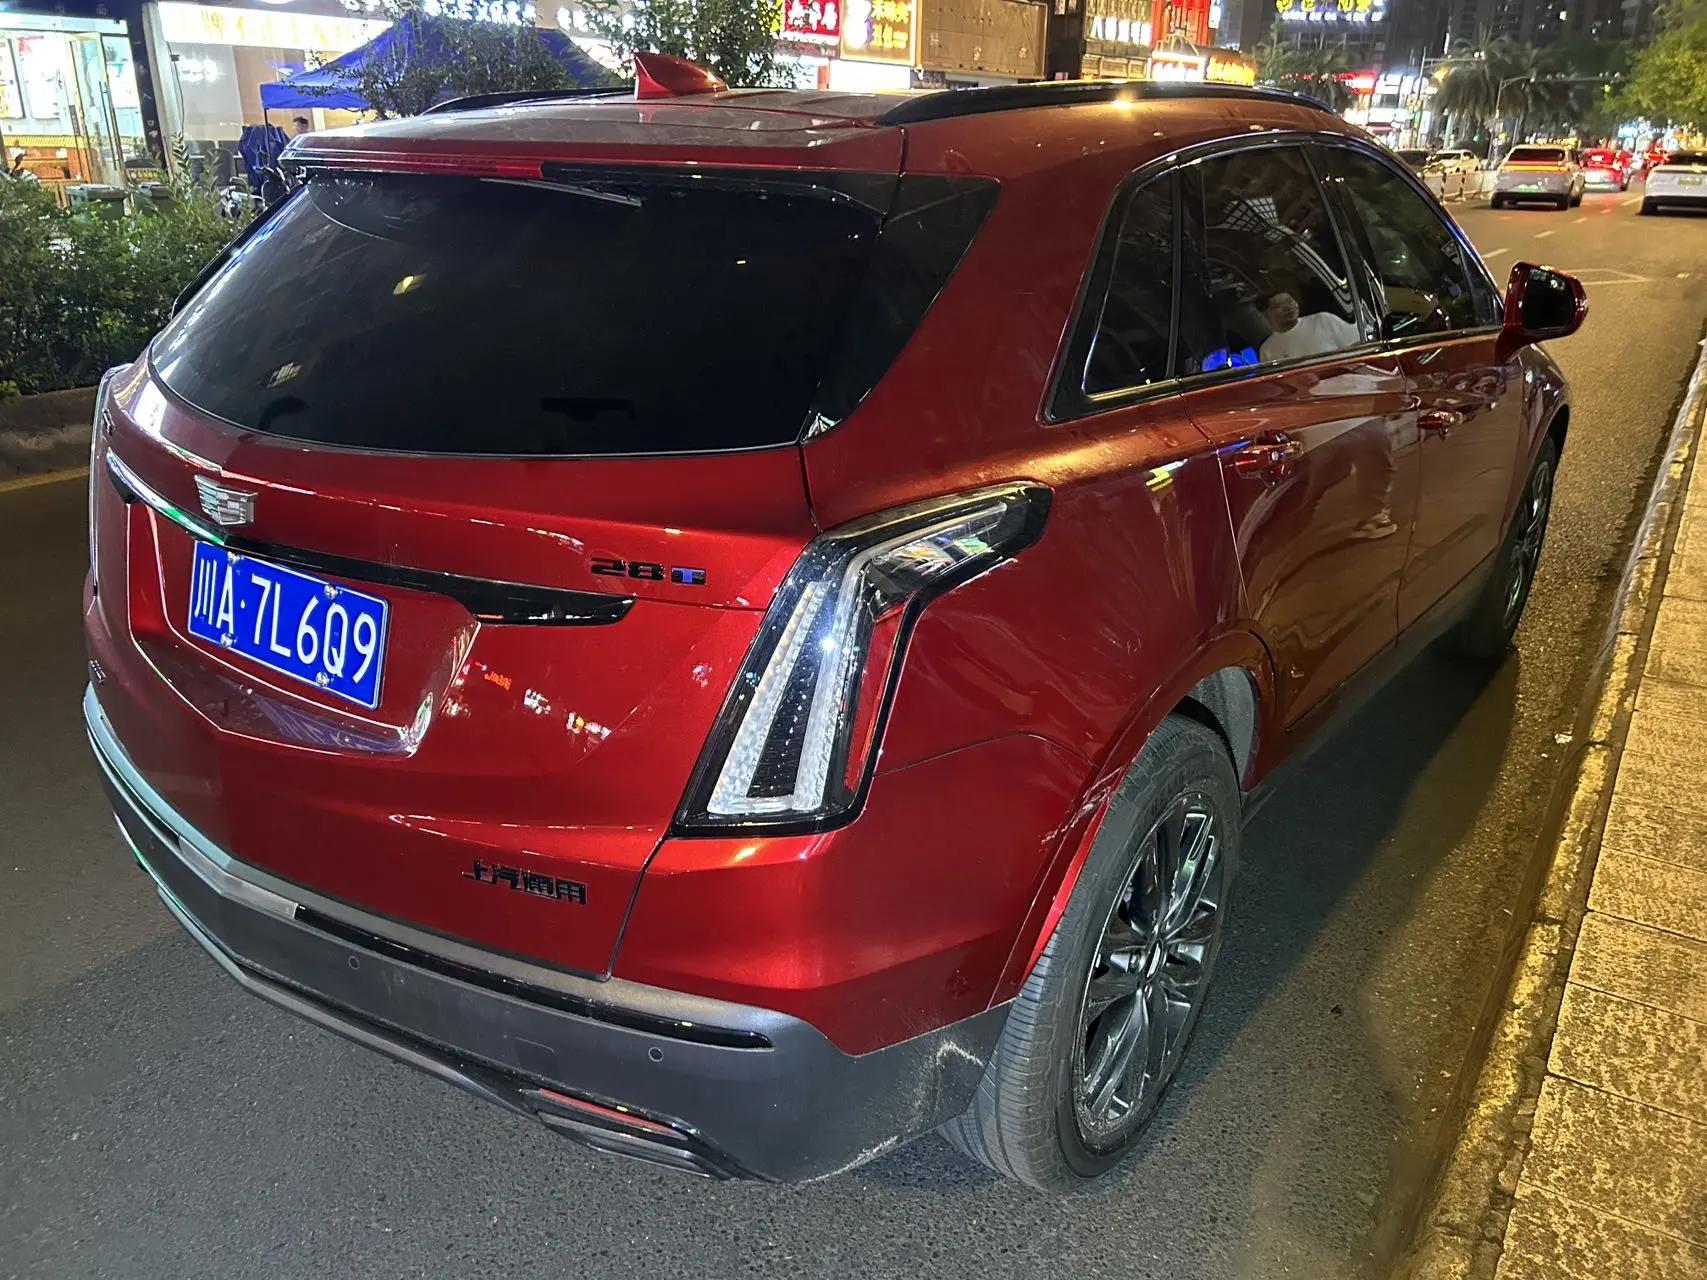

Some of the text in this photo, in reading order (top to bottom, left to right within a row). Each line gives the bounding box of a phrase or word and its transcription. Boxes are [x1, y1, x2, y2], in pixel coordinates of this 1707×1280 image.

[590, 556, 707, 586] 28T
[194, 557, 377, 684] 川A·7L6Q9
[461, 858, 588, 906] 上汽通用
